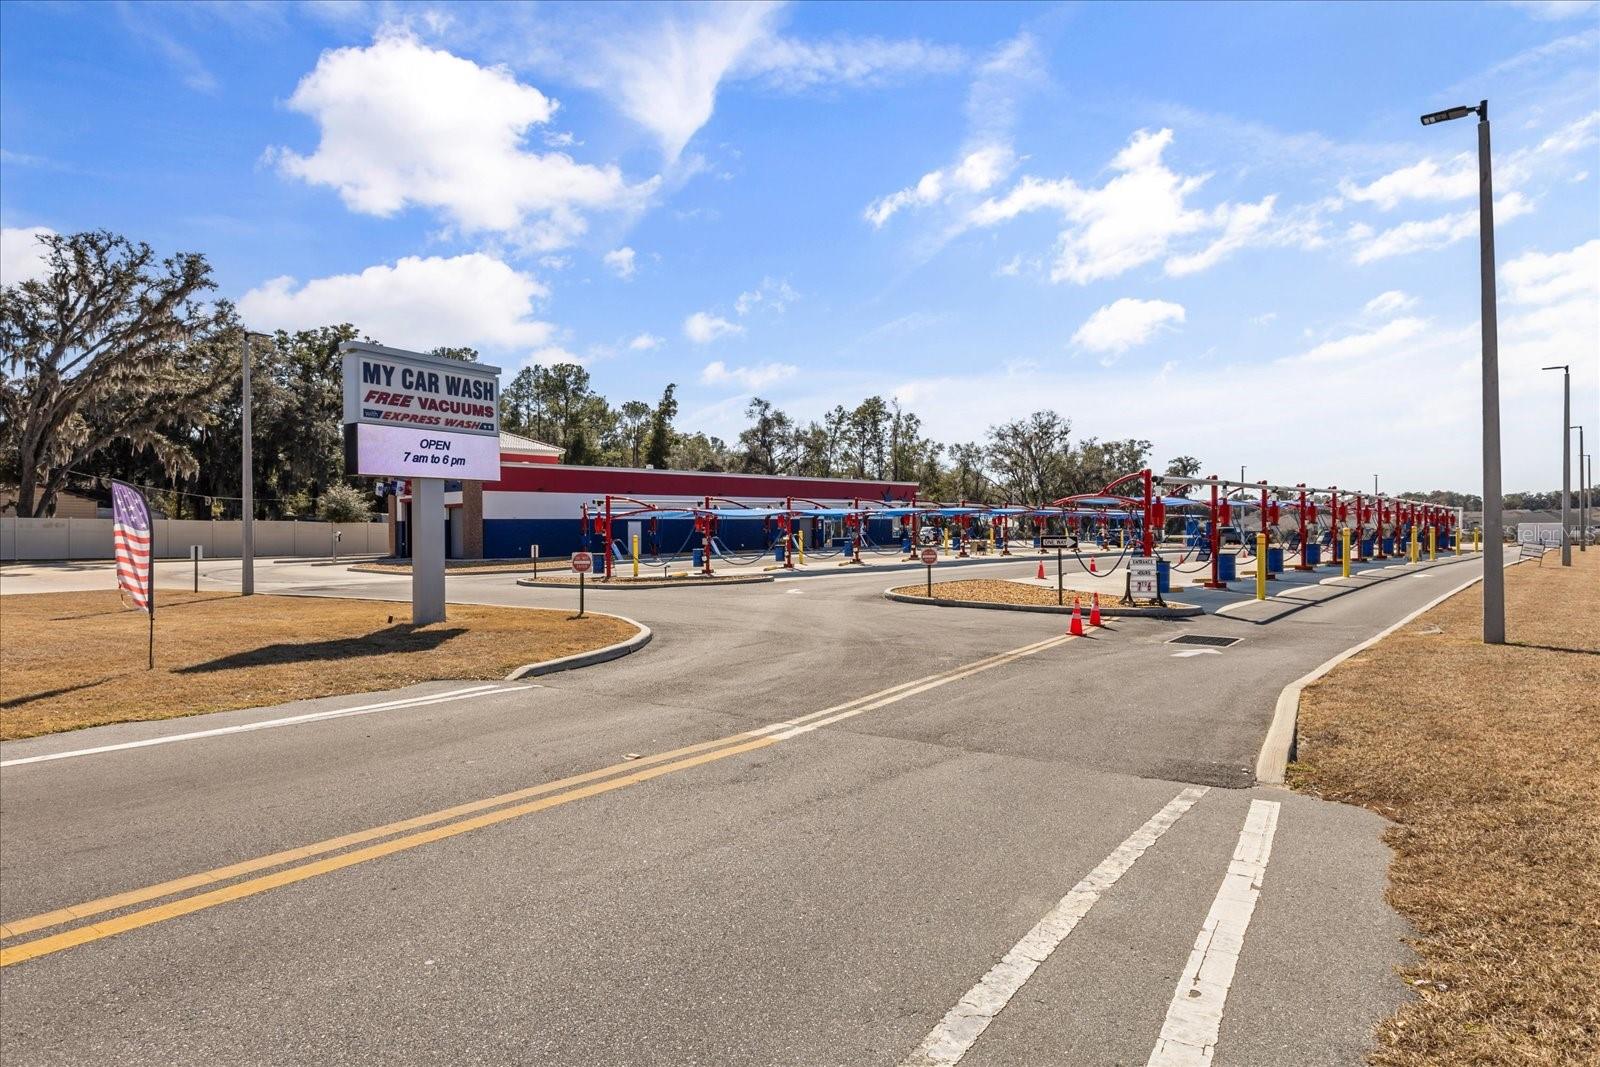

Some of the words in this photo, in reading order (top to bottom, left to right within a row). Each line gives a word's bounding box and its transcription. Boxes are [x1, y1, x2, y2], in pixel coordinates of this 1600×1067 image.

[363, 362, 395, 386] MY
[401, 368, 439, 393] CAR
[445, 375, 494, 401] WASH
[364, 390, 414, 408] FREE
[418, 397, 494, 418] VACUUMS
[382, 411, 441, 425] EXPRESS
[445, 418, 481, 430] WASH
[420, 439, 451, 450] OPEN
[404, 452, 411, 462] 7
[412, 454, 429, 463] am
[430, 454, 440, 464] to
[442, 455, 450, 465] 6
[450, 457, 466, 467] pm
